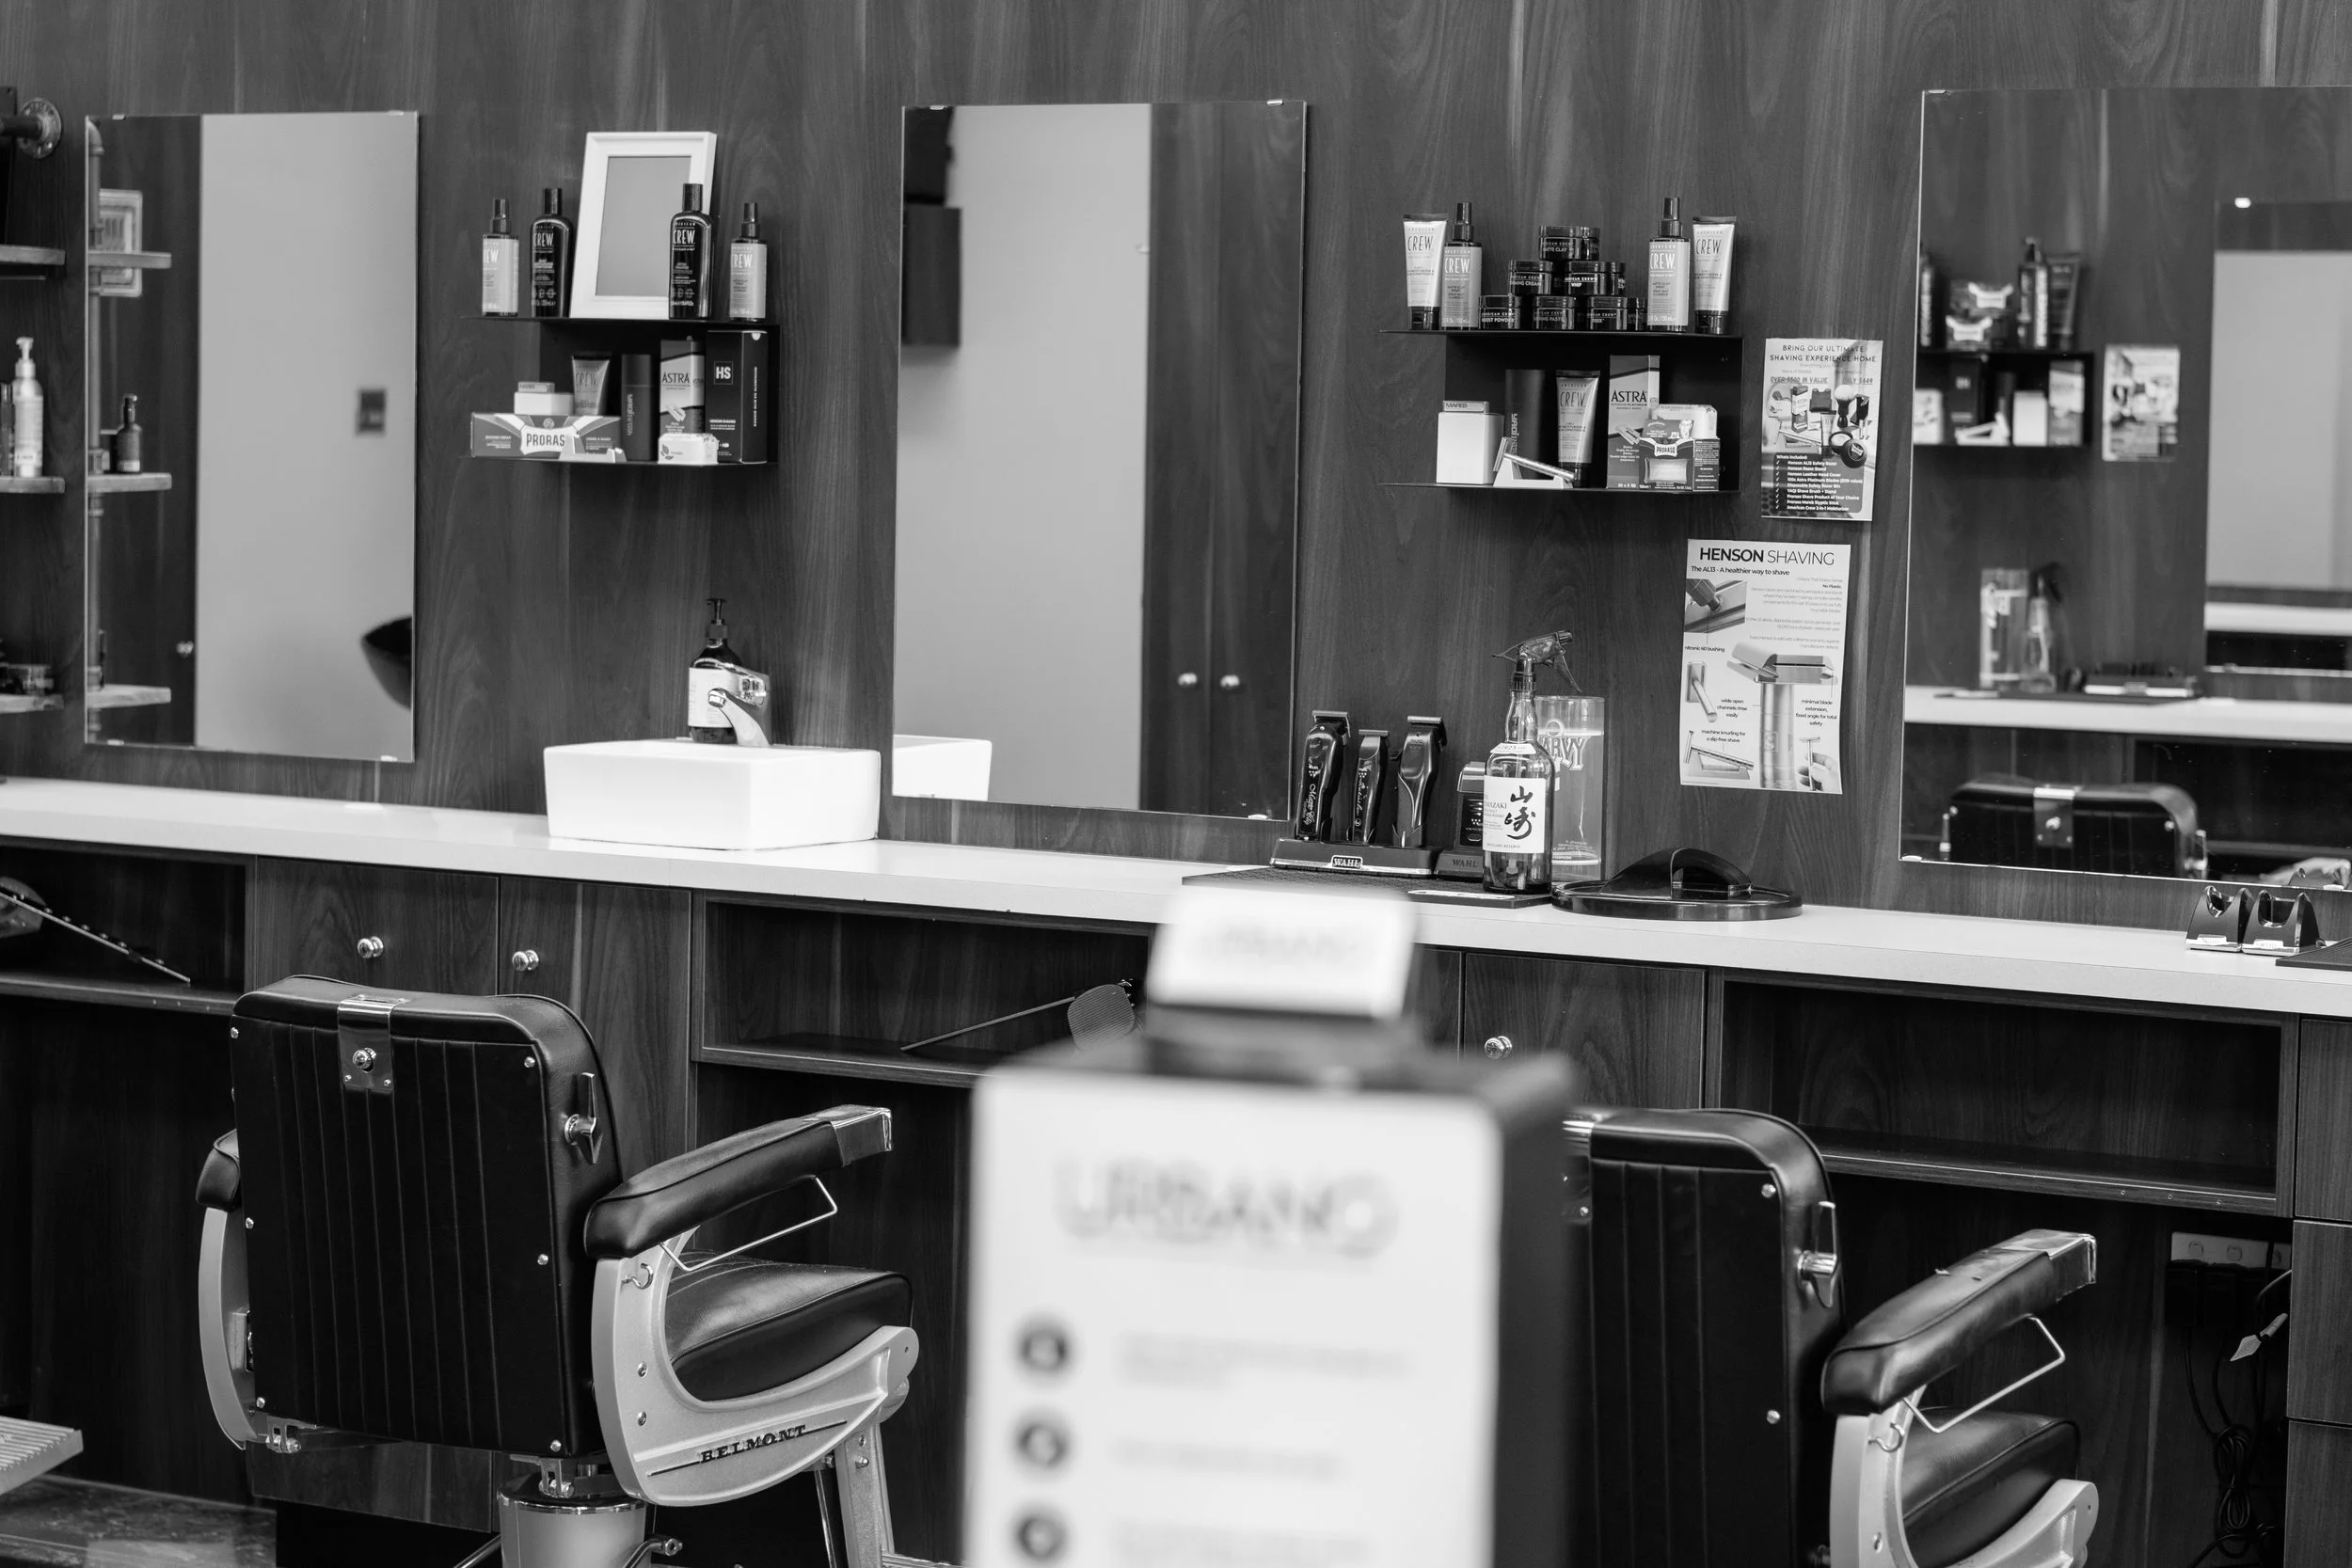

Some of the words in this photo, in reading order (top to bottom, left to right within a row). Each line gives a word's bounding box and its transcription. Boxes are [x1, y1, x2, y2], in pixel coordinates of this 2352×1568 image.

[674, 230, 696, 245] CREW
[1407, 235, 1434, 251] CREW
[1695, 238, 1722, 255] CREW
[1444, 258, 1470, 274] CREW
[1649, 253, 1676, 270] CREW
[576, 372, 598, 387] CREW
[662, 372, 691, 384] ASTRA
[716, 366, 732, 380] HS
[1560, 391, 1586, 407] CREW
[1611, 389, 1647, 403] ASTRA
[526, 433, 565, 447] PRORAS
[1699, 547, 1764, 562] HENSON
[1767, 549, 1835, 566] SHAVING
[1537, 736, 1591, 770] ARVY
[1307, 784, 1316, 810] Magic
[1303, 811, 1315, 826] Clip
[1504, 785, 1536, 840] 山崎
[1334, 857, 1361, 868] WAHL
[1452, 859, 1478, 868] WAHL
[701, 1424, 806, 1464] BELMONT
